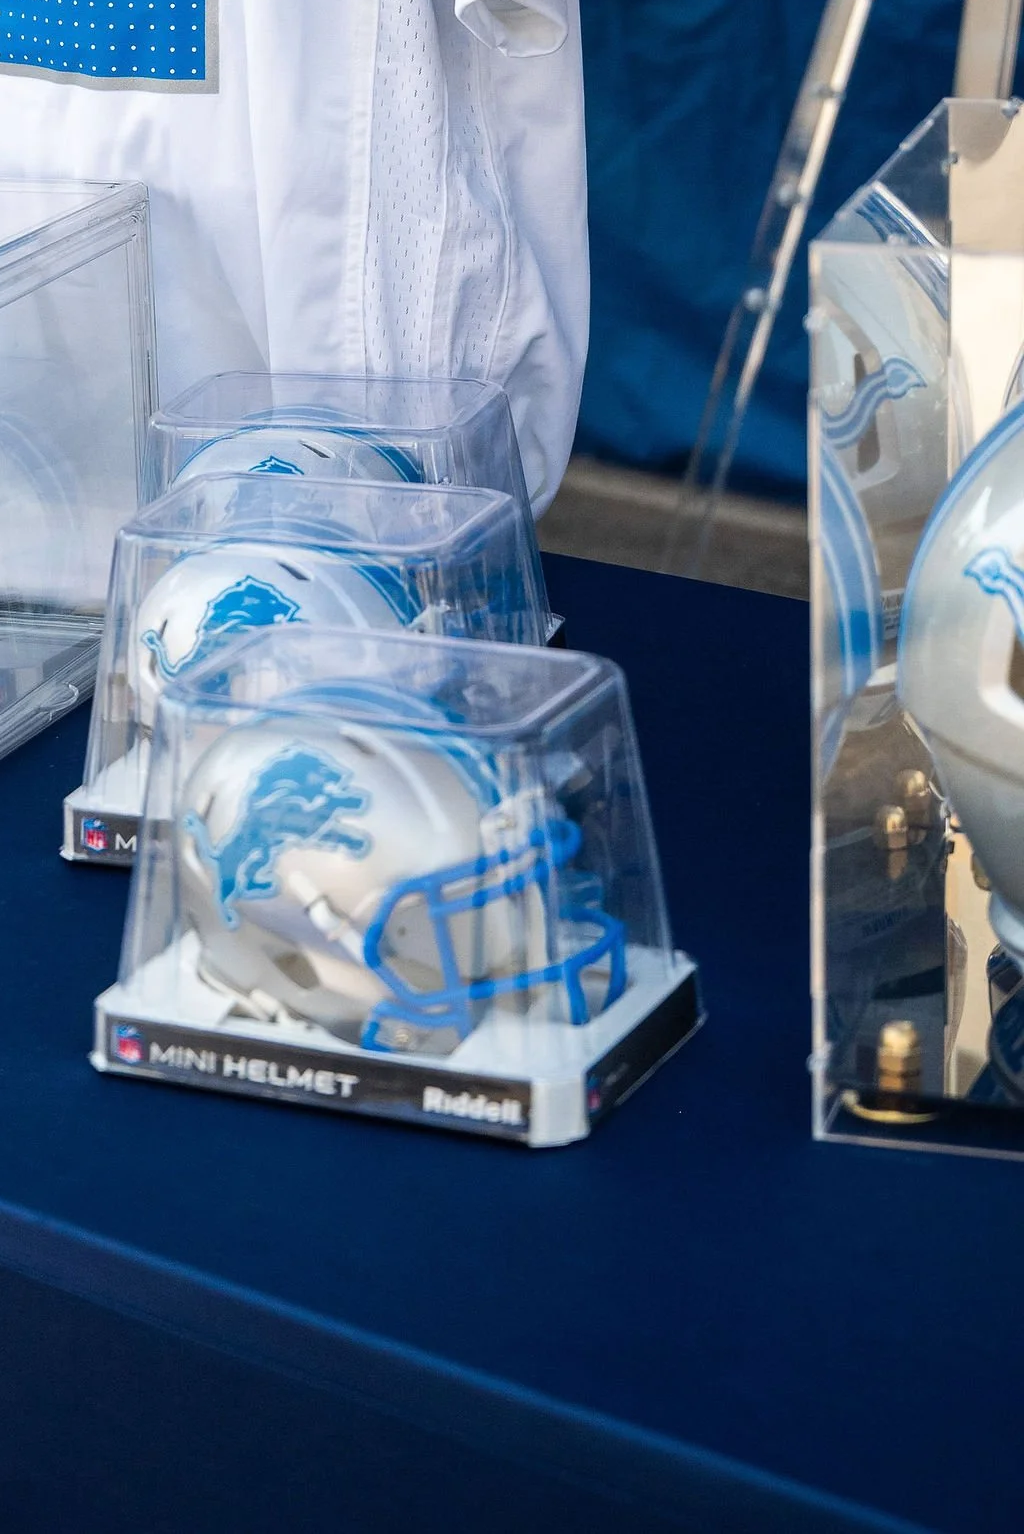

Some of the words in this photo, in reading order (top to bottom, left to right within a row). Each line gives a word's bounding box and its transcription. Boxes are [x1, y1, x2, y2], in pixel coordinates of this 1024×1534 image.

[149, 1041, 217, 1074] MINI
[223, 1054, 359, 1098] HELMET
[422, 1085, 522, 1126] Riddell
